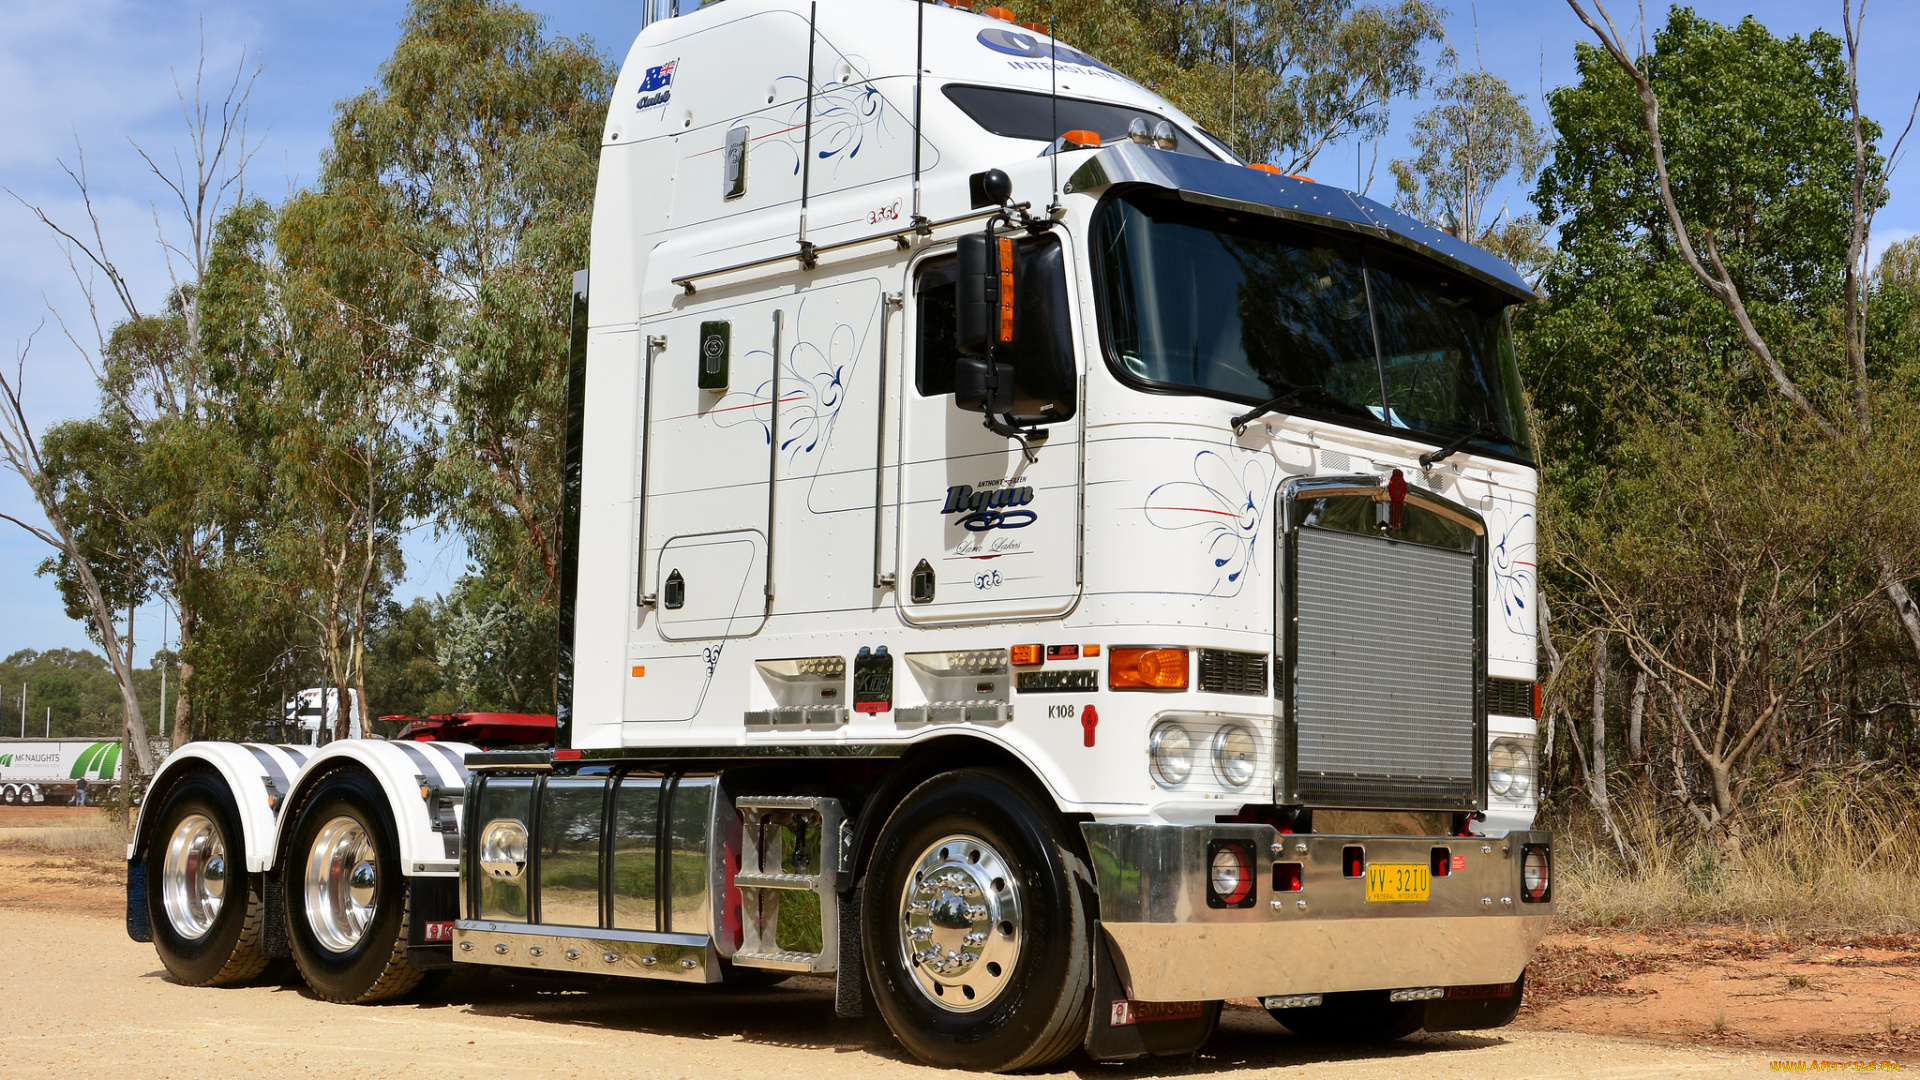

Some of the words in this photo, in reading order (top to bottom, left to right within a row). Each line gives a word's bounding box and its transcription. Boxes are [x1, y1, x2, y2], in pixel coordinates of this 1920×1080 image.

[1007, 61, 1121, 82] INTERSTATE
[977, 478, 1003, 488] ANTHONY
[1010, 476, 1028, 485] EILEEN
[941, 485, 1036, 524] Ryan
[1016, 670, 1099, 689] KENWORTH
[1048, 704, 1075, 719] K108
[1129, 1001, 1201, 1019] KENWORTH
